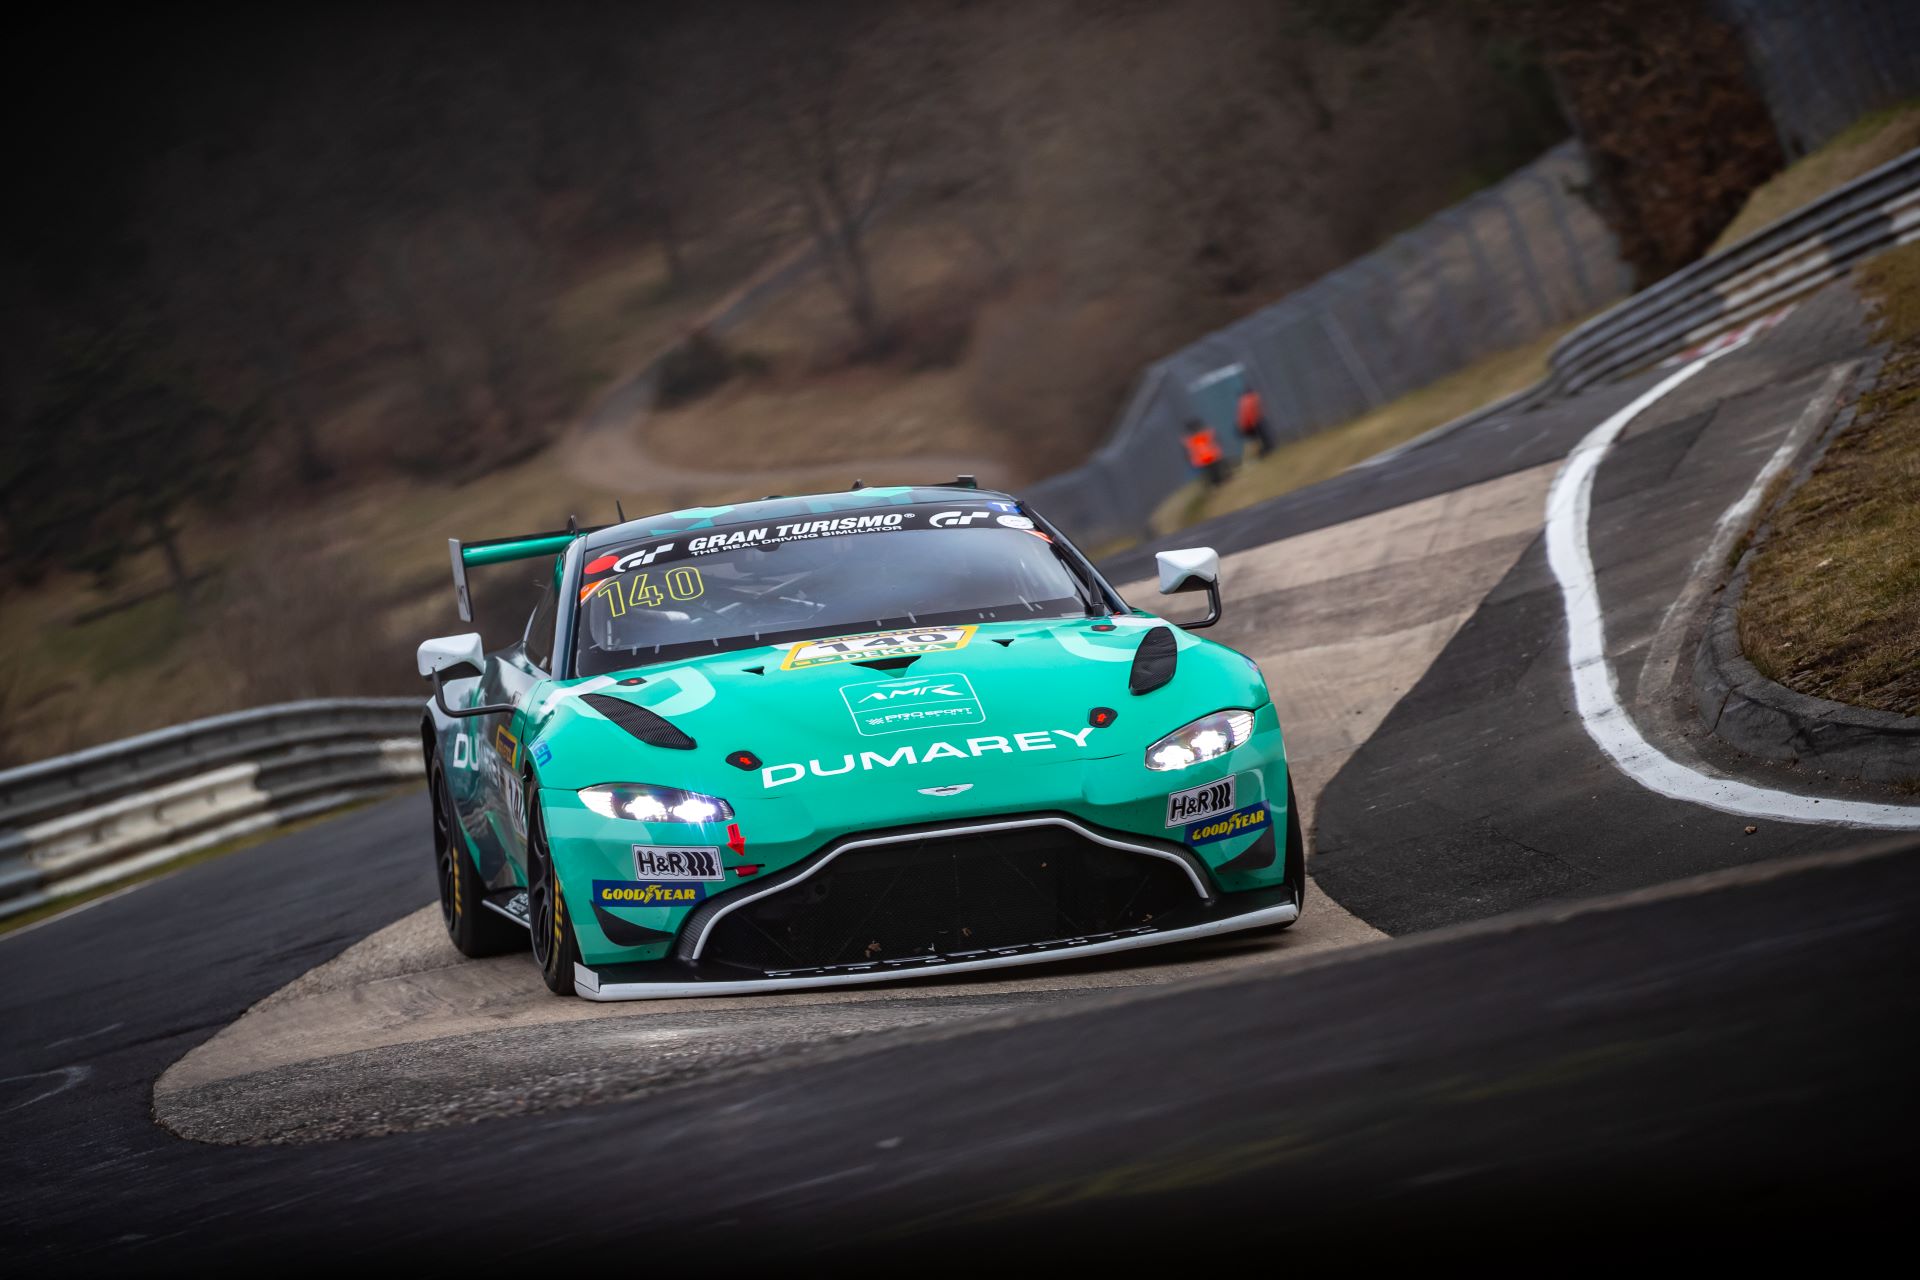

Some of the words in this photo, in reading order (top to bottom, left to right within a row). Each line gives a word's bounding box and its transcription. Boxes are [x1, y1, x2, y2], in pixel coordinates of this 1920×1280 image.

[688, 528, 768, 551] GRAN
[691, 547, 719, 556] THE
[722, 541, 759, 552] REAL
[762, 533, 819, 545] DRIVING
[821, 525, 903, 537] SIMULATOR
[598, 566, 704, 617] 140
[819, 633, 948, 653] 140
[840, 643, 947, 660] DEKRA
[858, 684, 964, 703] AMR
[761, 727, 1095, 789] DUMAREY
[1171, 789, 1210, 822] H&R
[1192, 809, 1265, 841] GOODYEAR
[636, 850, 687, 875] H&R
[602, 887, 695, 902] GOODYEAR
